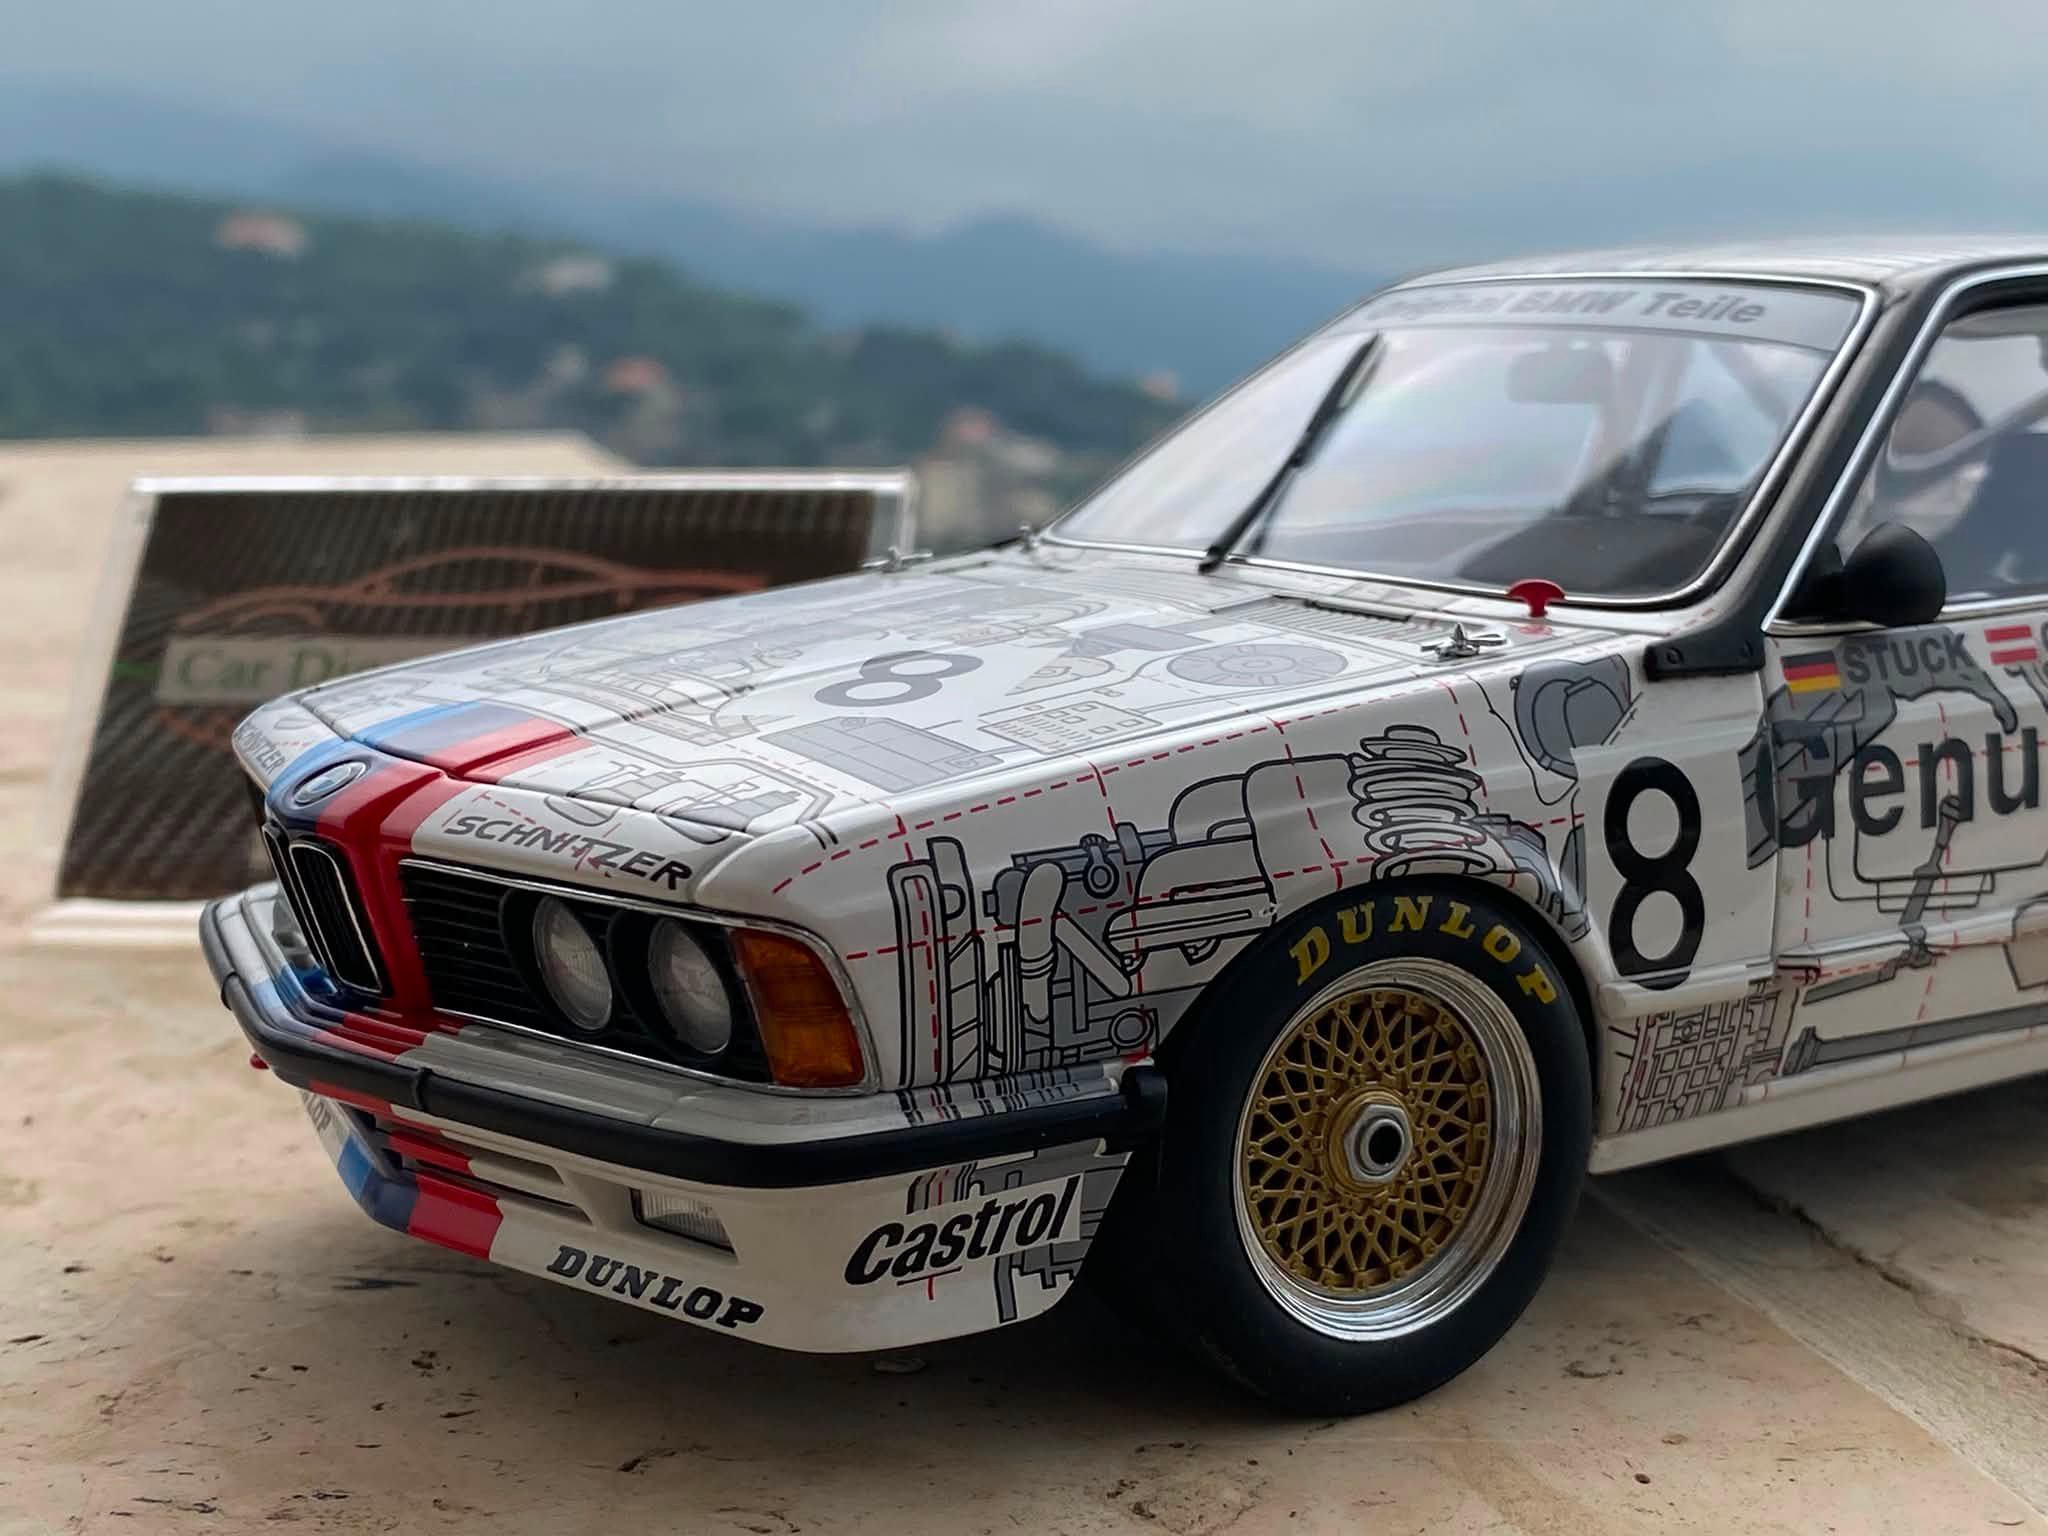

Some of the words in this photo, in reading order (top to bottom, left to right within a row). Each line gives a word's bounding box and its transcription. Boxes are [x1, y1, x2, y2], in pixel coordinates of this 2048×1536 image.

[1639, 291, 1768, 324] Teile
[178, 648, 272, 690] Car
[813, 650, 984, 707] 8
[1842, 632, 1978, 685] STUCK
[1755, 726, 2040, 850] Genu
[443, 815, 693, 891] SCHNITZER
[1603, 756, 1706, 992] 8
[1288, 895, 1558, 1005] DUNLOP
[843, 1176, 1080, 1286] Castrol
[546, 1245, 766, 1330] DUNLOP
